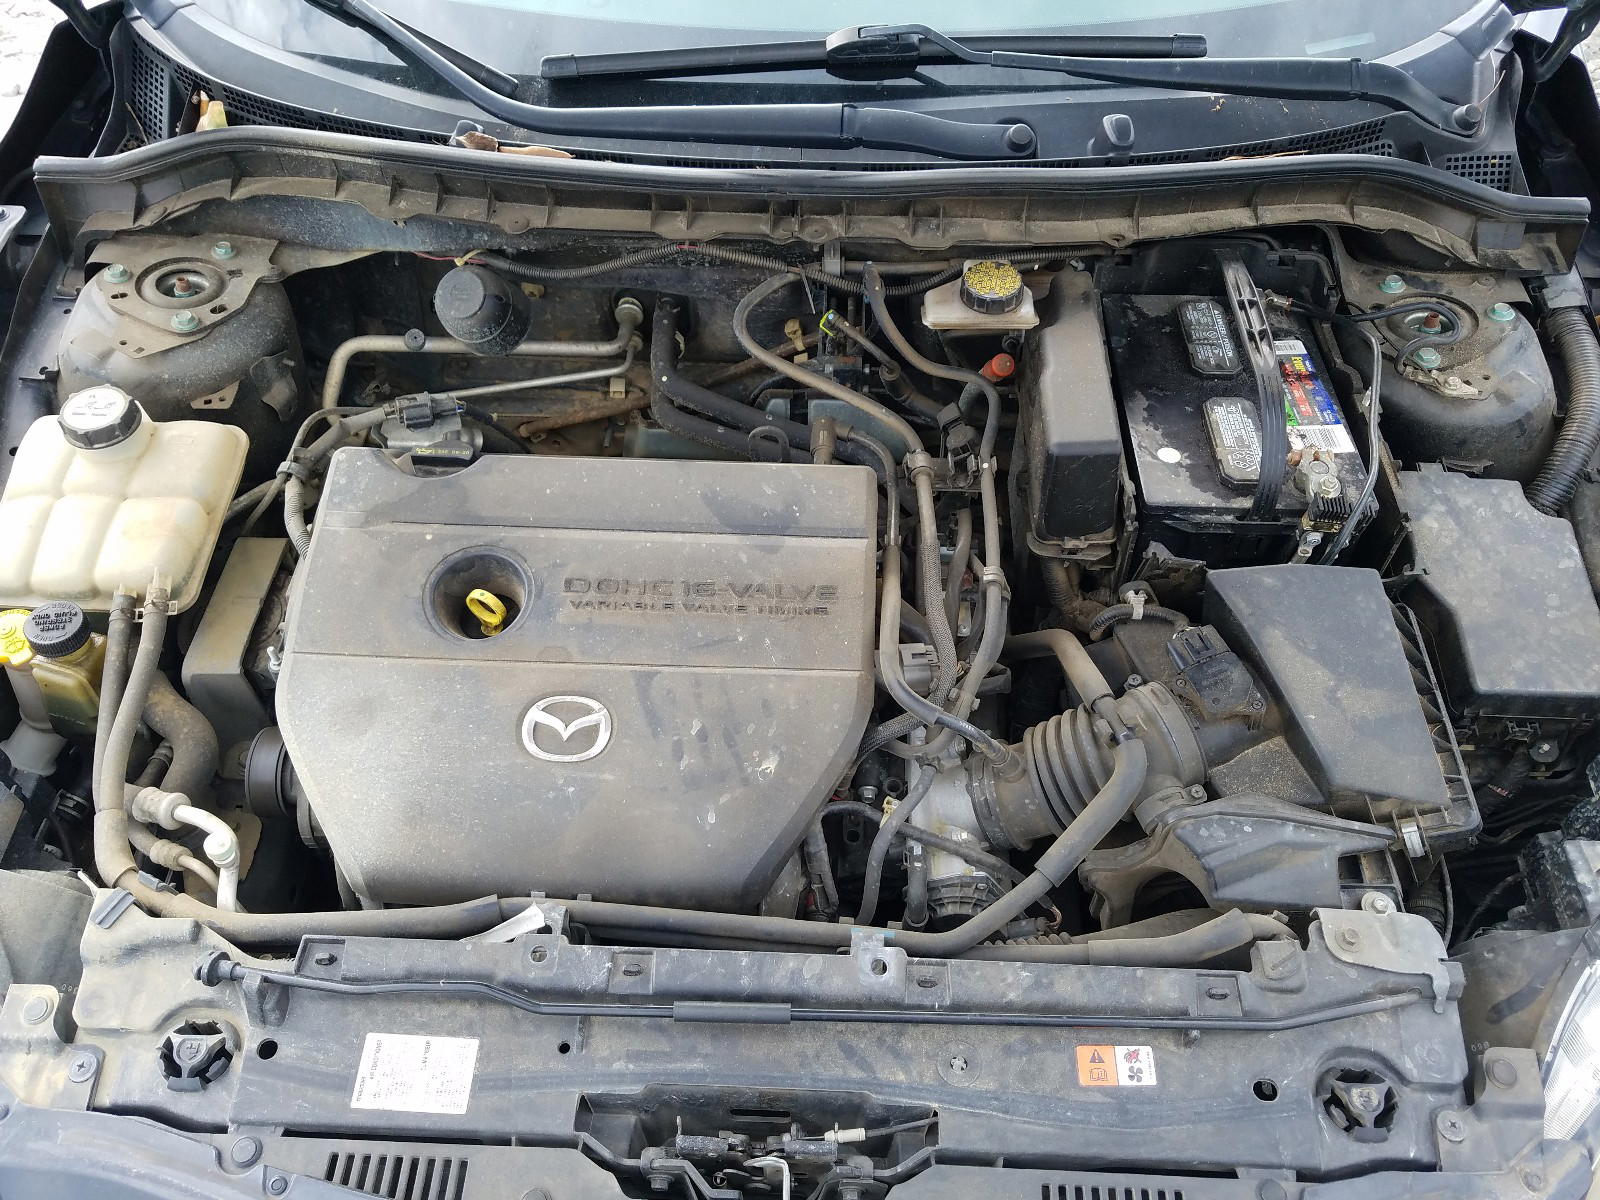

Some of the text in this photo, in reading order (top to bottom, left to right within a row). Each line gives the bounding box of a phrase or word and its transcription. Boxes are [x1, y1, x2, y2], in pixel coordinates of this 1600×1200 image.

[563, 577, 674, 596] DOHC
[568, 600, 829, 616] VARIABLE VALVE TIMING
[32, 613, 51, 621] ONLY
[54, 610, 77, 619] FLUID
[34, 616, 73, 626] STEERING
[40, 624, 65, 632] POWER
